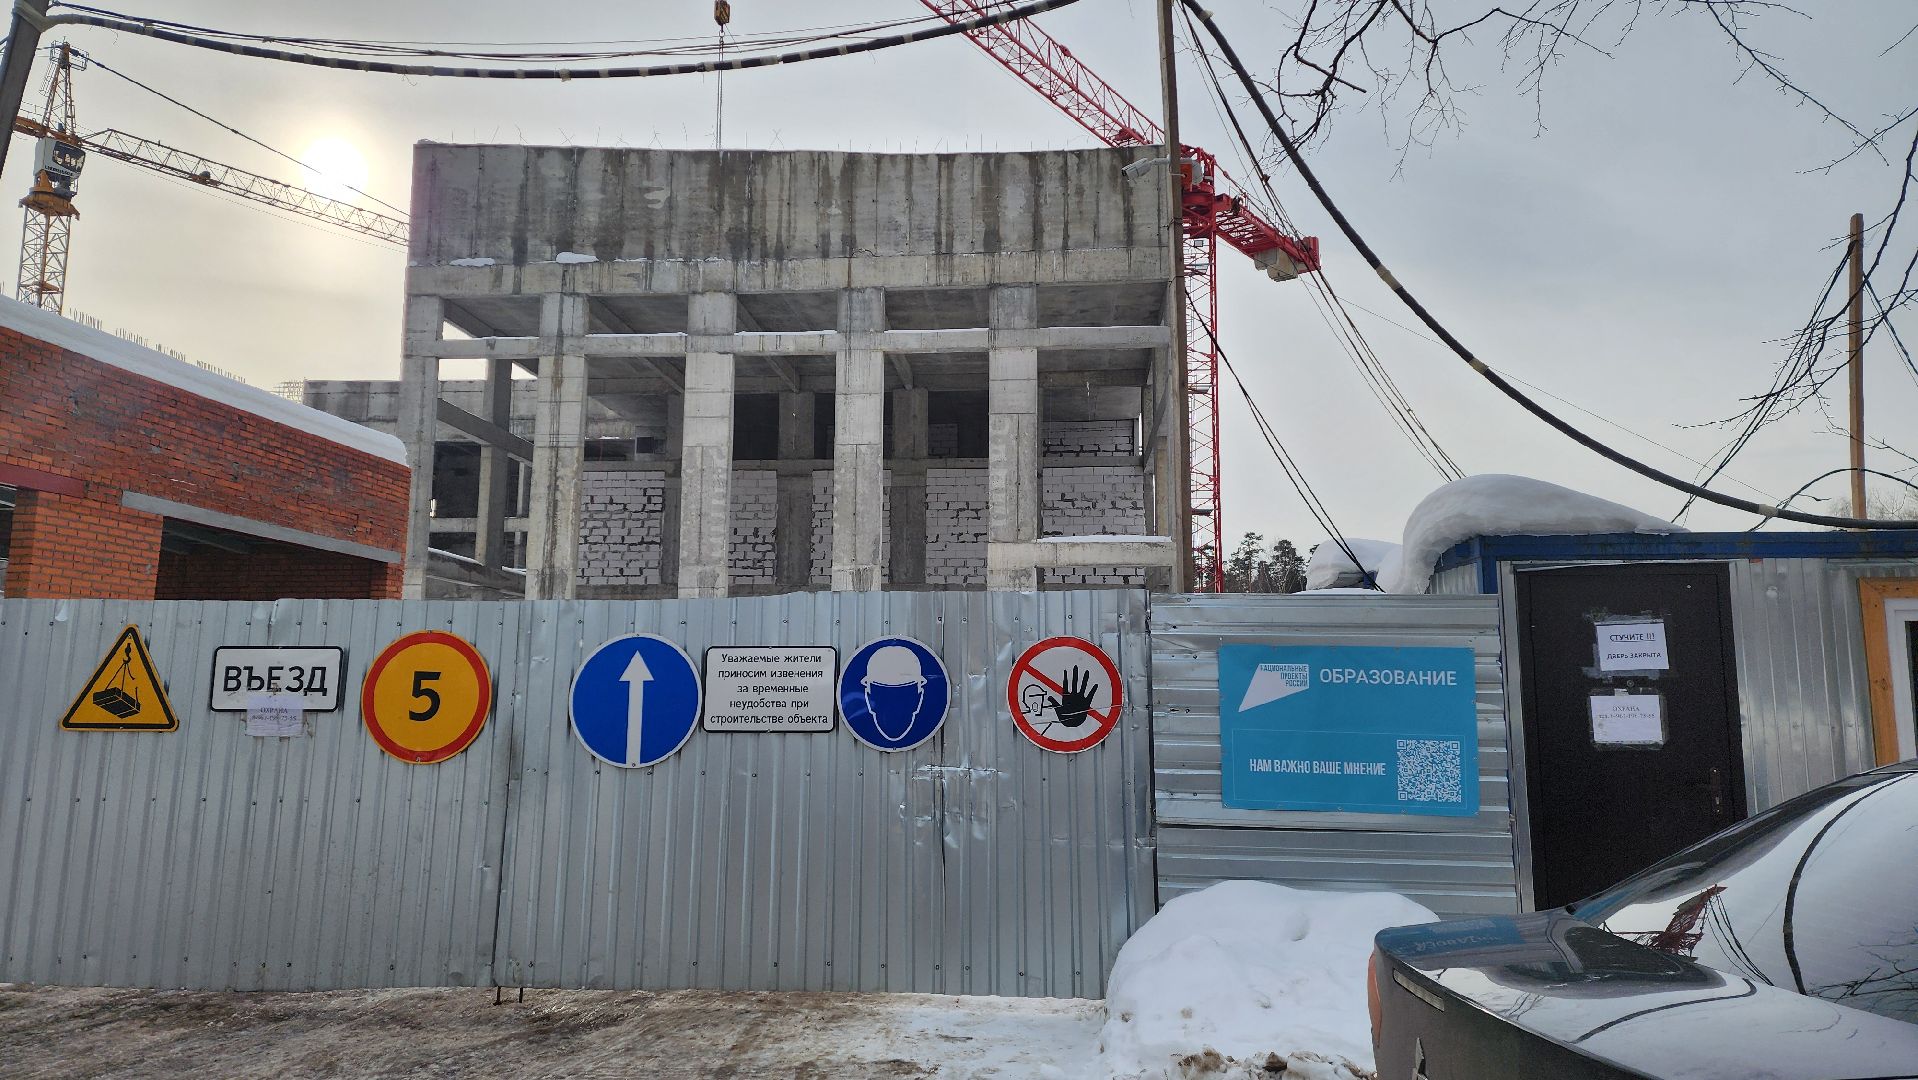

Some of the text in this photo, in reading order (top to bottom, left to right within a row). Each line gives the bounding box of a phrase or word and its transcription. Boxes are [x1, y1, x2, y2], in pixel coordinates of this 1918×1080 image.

[1610, 633, 1643, 641] СТУЧИТЕ
[721, 653, 822, 663] Уважаемые жители
[223, 665, 328, 696] ВЪЕЗД
[718, 670, 767, 680] приносим
[1280, 672, 1307, 680] ПРОЕКТЫ
[1320, 668, 1457, 686] ОБРАЗОВАНИЕ
[1285, 679, 1307, 687] РОССИИ
[737, 685, 809, 695] за временные
[408, 671, 441, 722] 5
[730, 698, 809, 710] неудобства при
[710, 714, 828, 726] строительстве объекта
[1249, 758, 1387, 776] НАМ ВАЖНО ВАШЕ МНЕНИЕ
